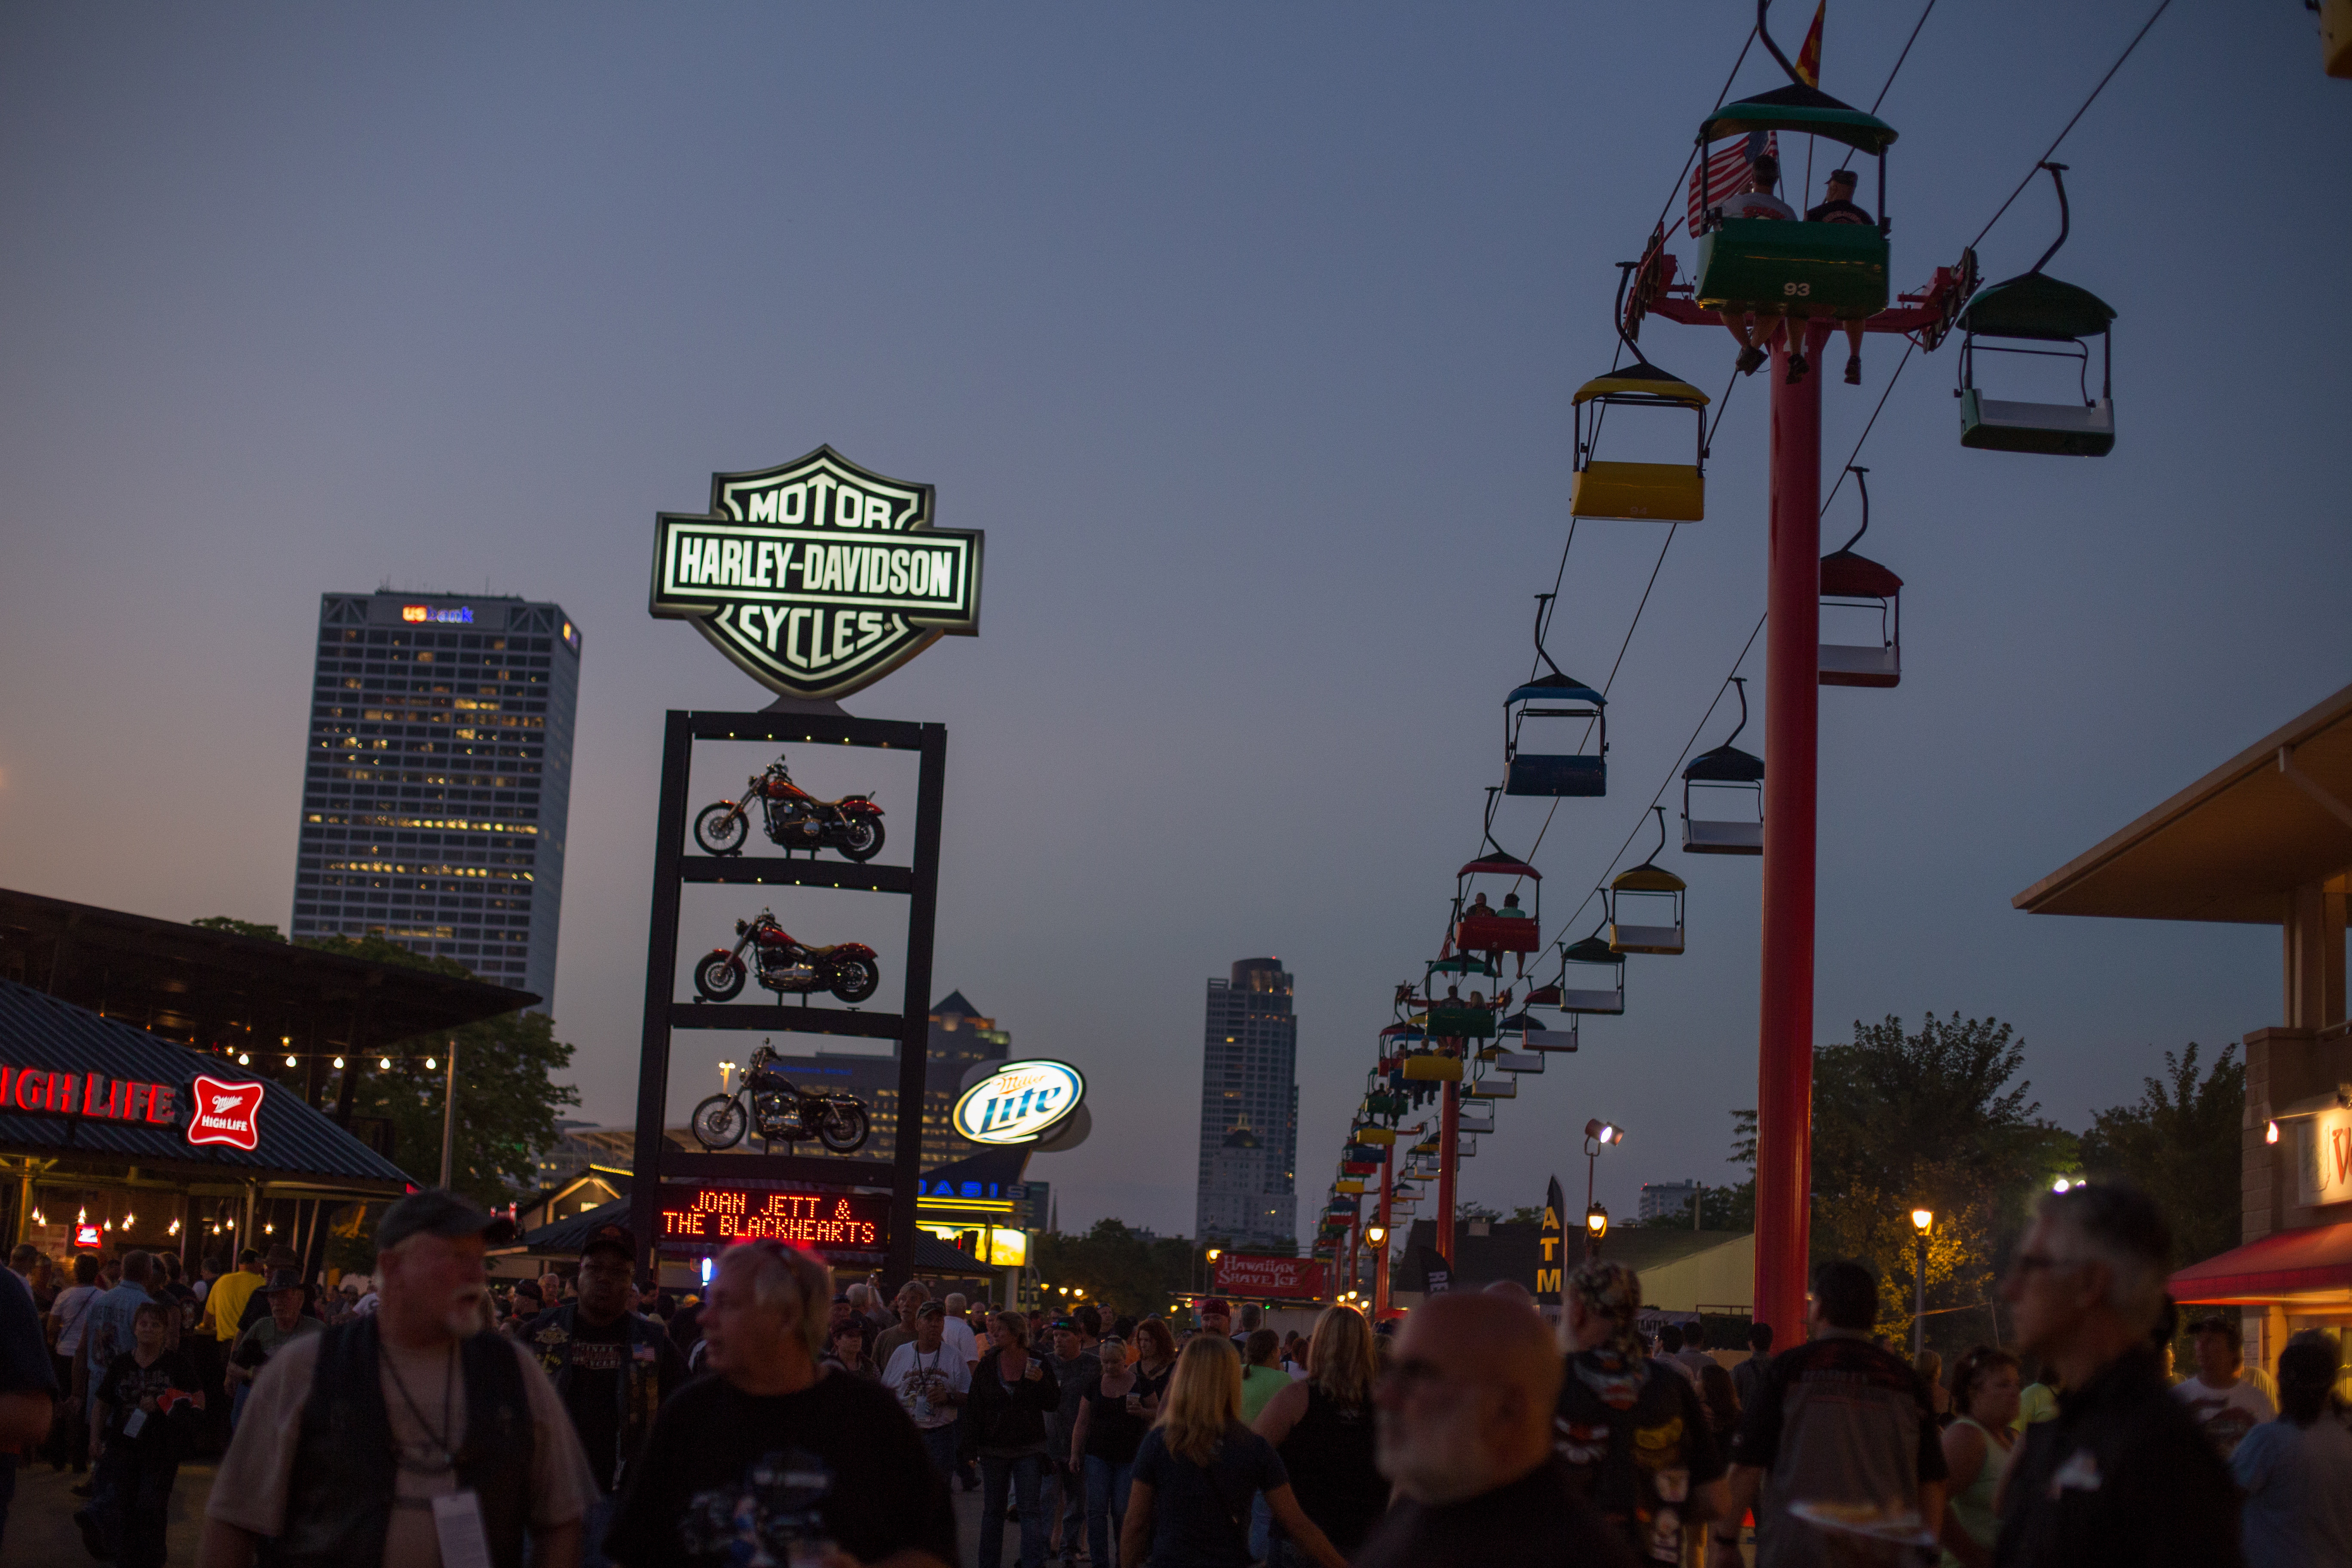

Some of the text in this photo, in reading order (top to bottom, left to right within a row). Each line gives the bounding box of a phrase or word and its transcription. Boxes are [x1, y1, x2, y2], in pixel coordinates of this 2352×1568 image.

[1784, 282, 1810, 296] 93
[749, 472, 891, 530] MOTOR
[1630, 506, 1647, 515] 94
[679, 537, 952, 597] HARLEY-DAVIDSON
[739, 604, 883, 669] CYCLES
[0, 1065, 176, 1123] IGH LIFE
[992, 1075, 1047, 1093] Miller
[212, 1095, 243, 1113] Miller
[977, 1086, 1061, 1135] Lite
[201, 1115, 248, 1132] HIGH LIFE
[691, 1191, 851, 1220] JOAN JETT &
[663, 1211, 875, 1243] THE BLACKHEARTS
[1537, 1206, 1562, 1293] ATM
